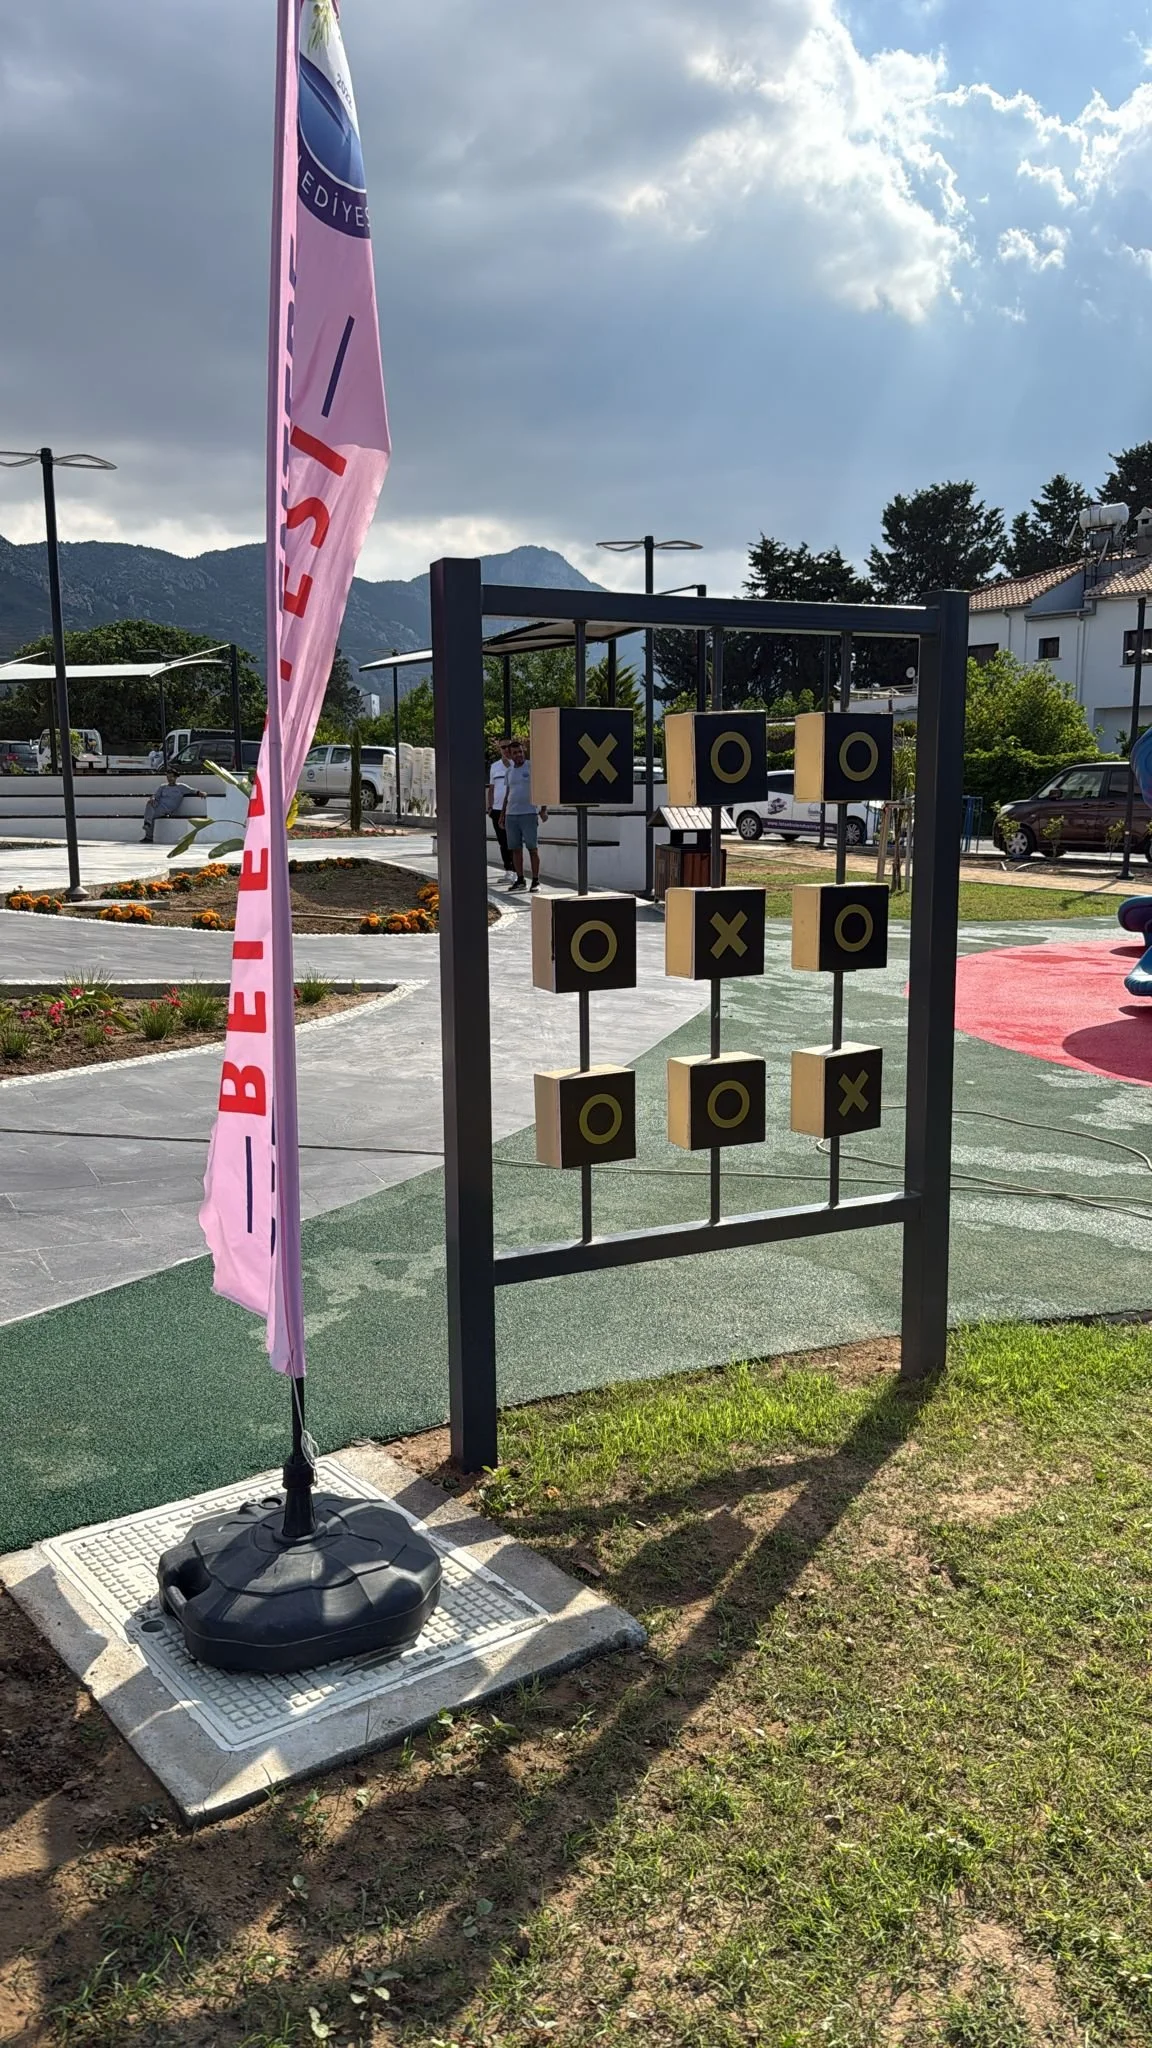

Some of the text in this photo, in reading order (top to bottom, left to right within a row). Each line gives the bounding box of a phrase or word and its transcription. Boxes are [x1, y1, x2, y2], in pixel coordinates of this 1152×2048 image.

[577, 732, 618, 785] X
[710, 731, 751, 784] O
[839, 731, 878, 782] O
[570, 920, 618, 973] O
[709, 910, 749, 959] X
[834, 904, 873, 953] O
[707, 1080, 750, 1128] O
[838, 1069, 869, 1117] X
[579, 1093, 622, 1146] O
